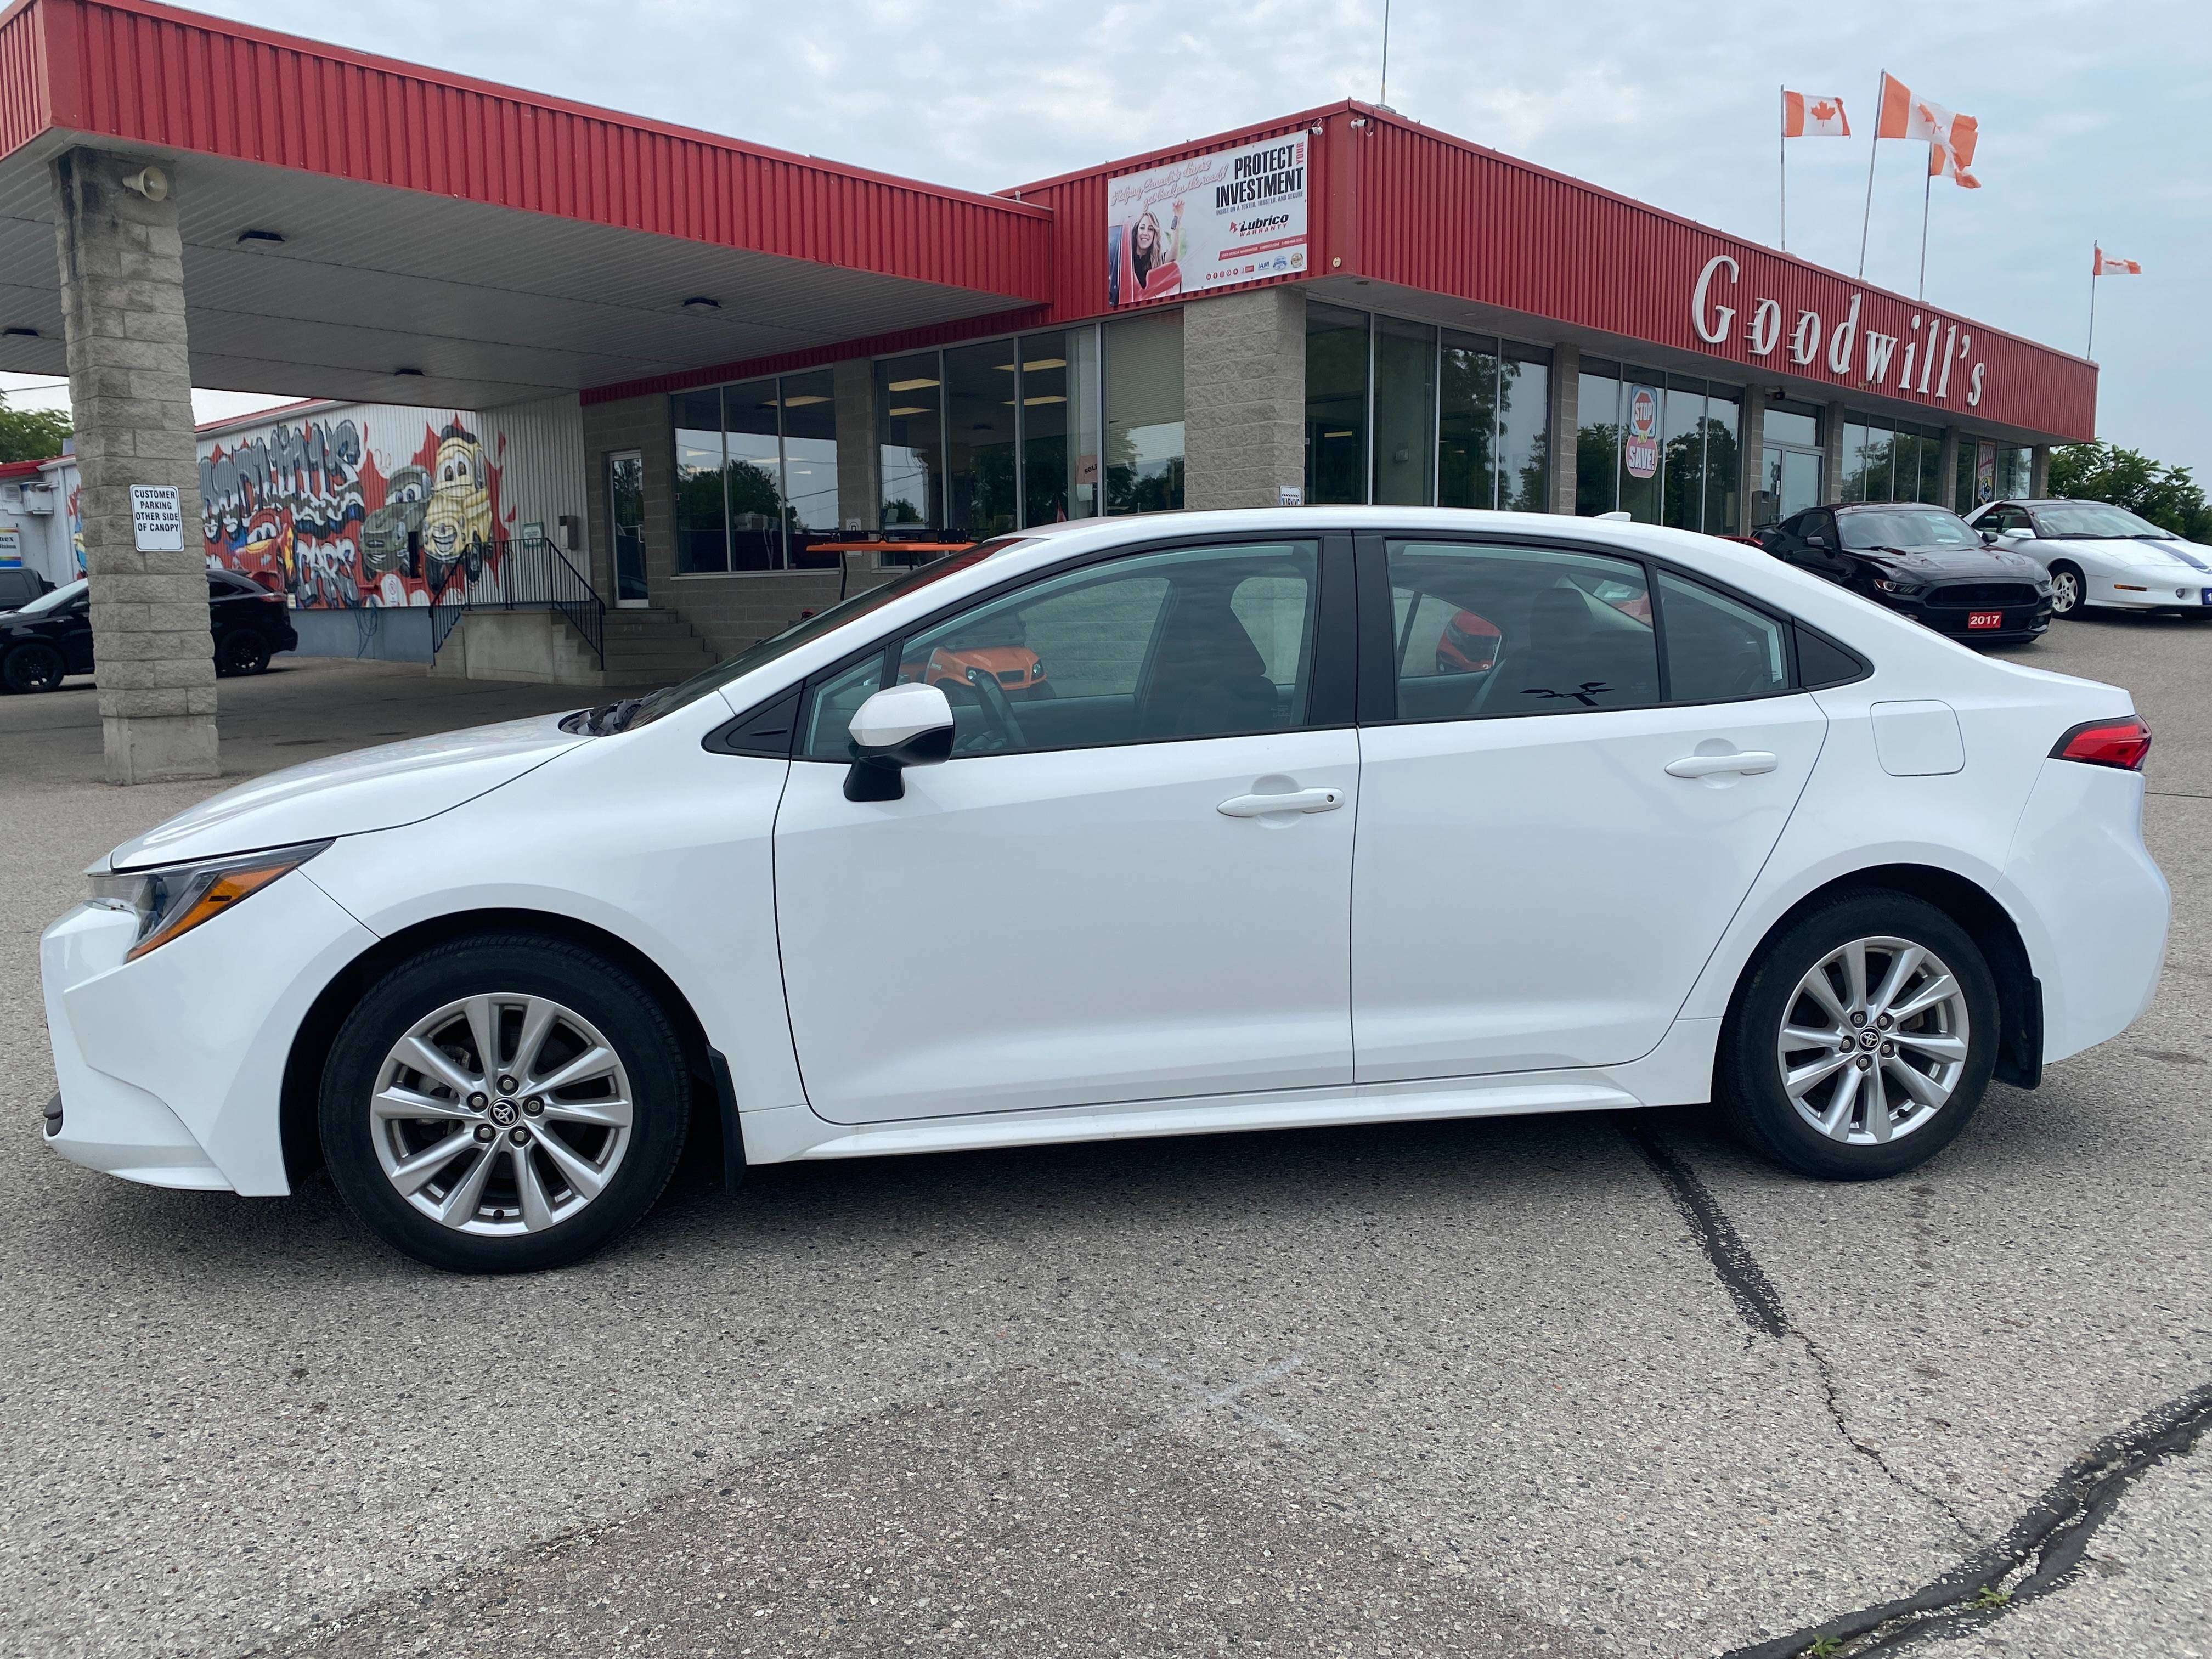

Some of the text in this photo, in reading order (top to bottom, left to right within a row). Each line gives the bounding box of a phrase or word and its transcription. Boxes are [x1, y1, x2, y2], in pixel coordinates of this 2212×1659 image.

[1234, 142, 1304, 180] PROTECT YOUR
[1111, 186, 1143, 206] Helping
[1143, 168, 1181, 193] Canada's
[1216, 167, 1304, 208] INVESTMENT
[1288, 191, 1304, 200] SECURE
[1239, 214, 1289, 232] Lubrico
[1240, 223, 1288, 237] WARRANTY
[1692, 255, 1985, 407] Goodwill's
[1634, 402, 1653, 421] STOP
[1629, 445, 1655, 471] SAVE!
[134, 490, 175, 499] CUSTOMER
[140, 501, 172, 510] PARKING
[136, 512, 179, 521] OTHER SIDE
[138, 523, 179, 532] OF CANOPY
[1970, 615, 2000, 625] 2017
